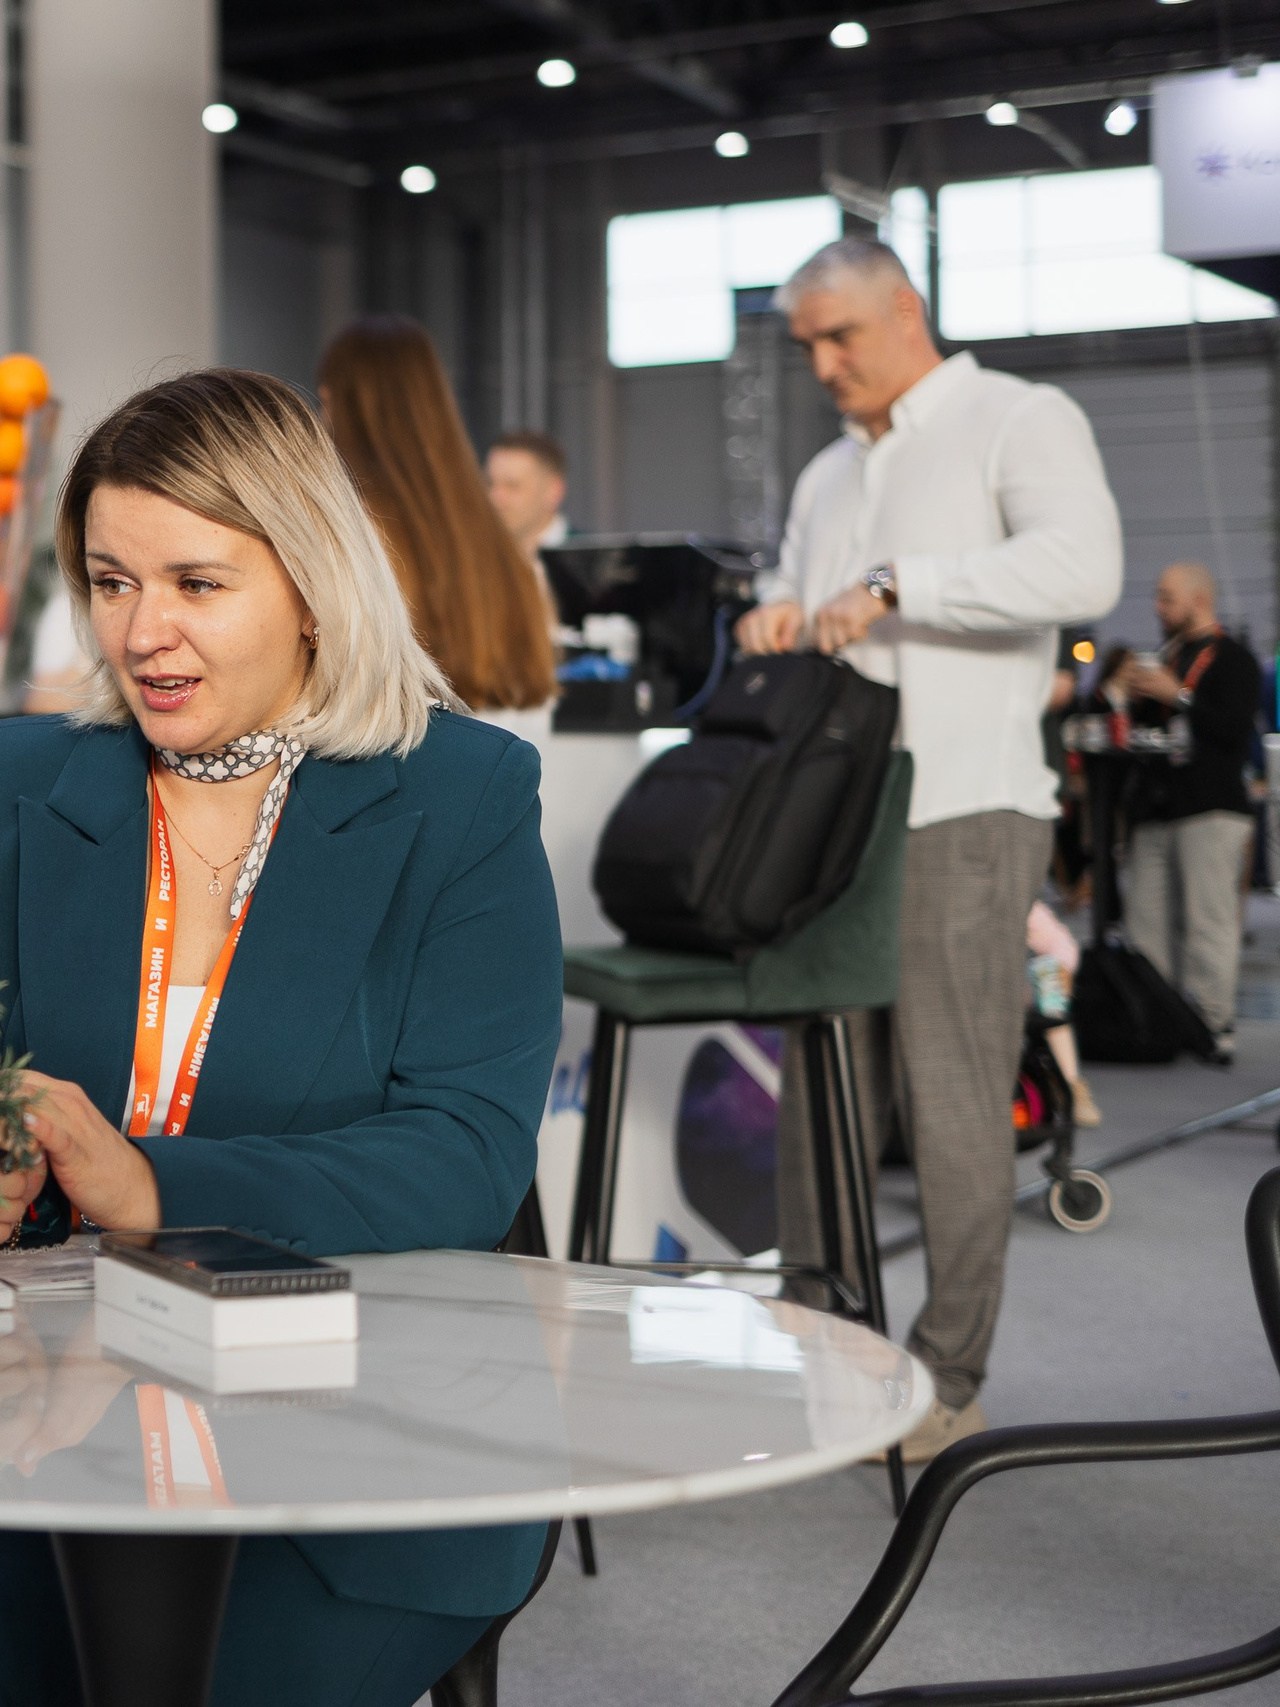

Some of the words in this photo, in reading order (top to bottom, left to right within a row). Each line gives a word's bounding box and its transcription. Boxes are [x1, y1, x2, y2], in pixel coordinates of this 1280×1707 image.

[157, 818, 171, 901] РЕСТОРАН
[154, 917, 168, 931] И
[145, 947, 165, 1028] МАГАЗИН
[179, 1092, 191, 1107] И
